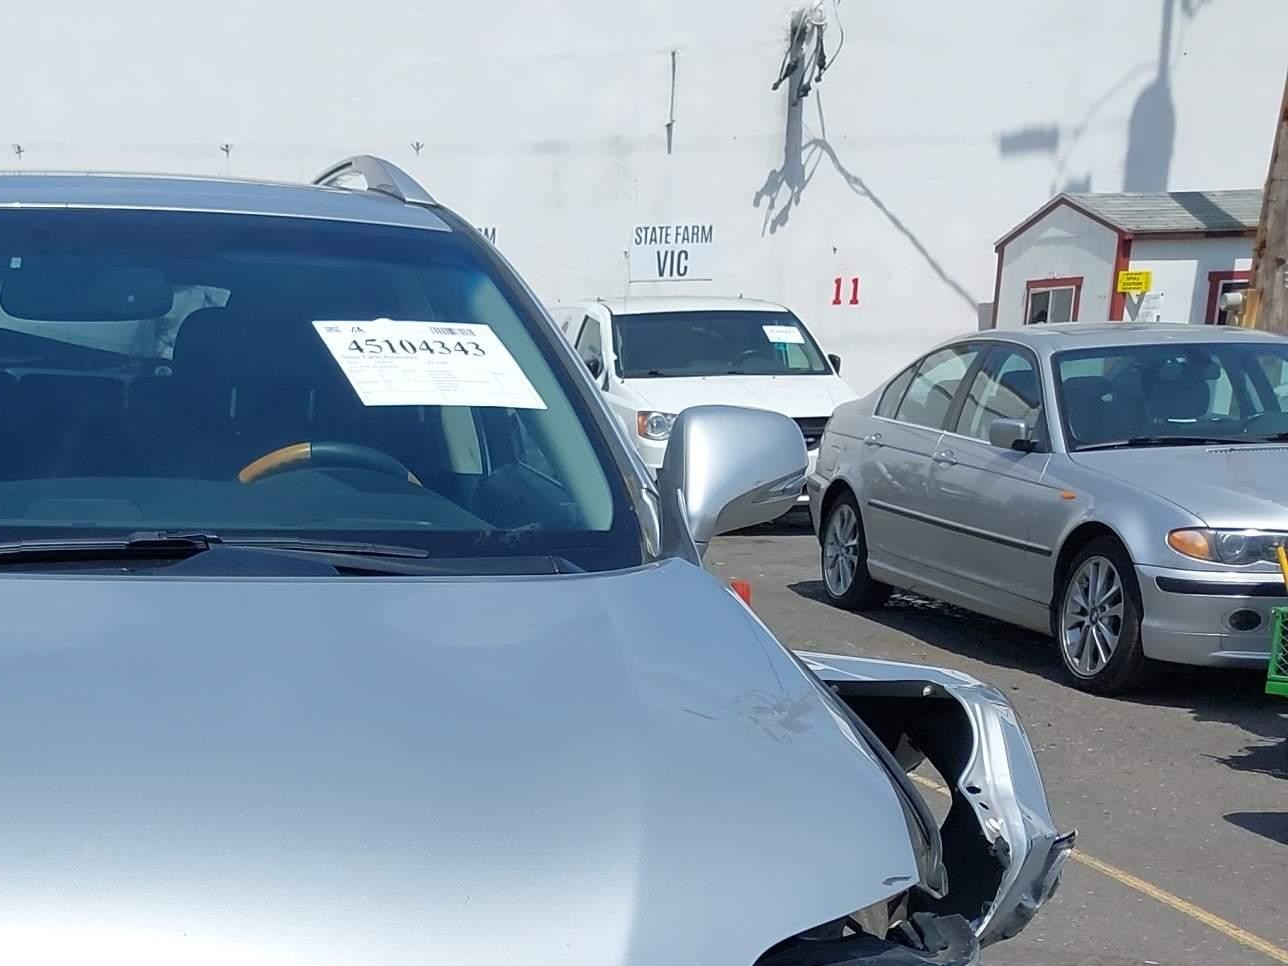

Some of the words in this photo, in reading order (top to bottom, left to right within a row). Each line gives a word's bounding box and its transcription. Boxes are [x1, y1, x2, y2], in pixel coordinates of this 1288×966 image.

[634, 225, 671, 246] STATE
[674, 224, 713, 244] FARM
[656, 249, 689, 278] VIC
[832, 277, 859, 305] 11
[348, 338, 486, 358] 45104343
